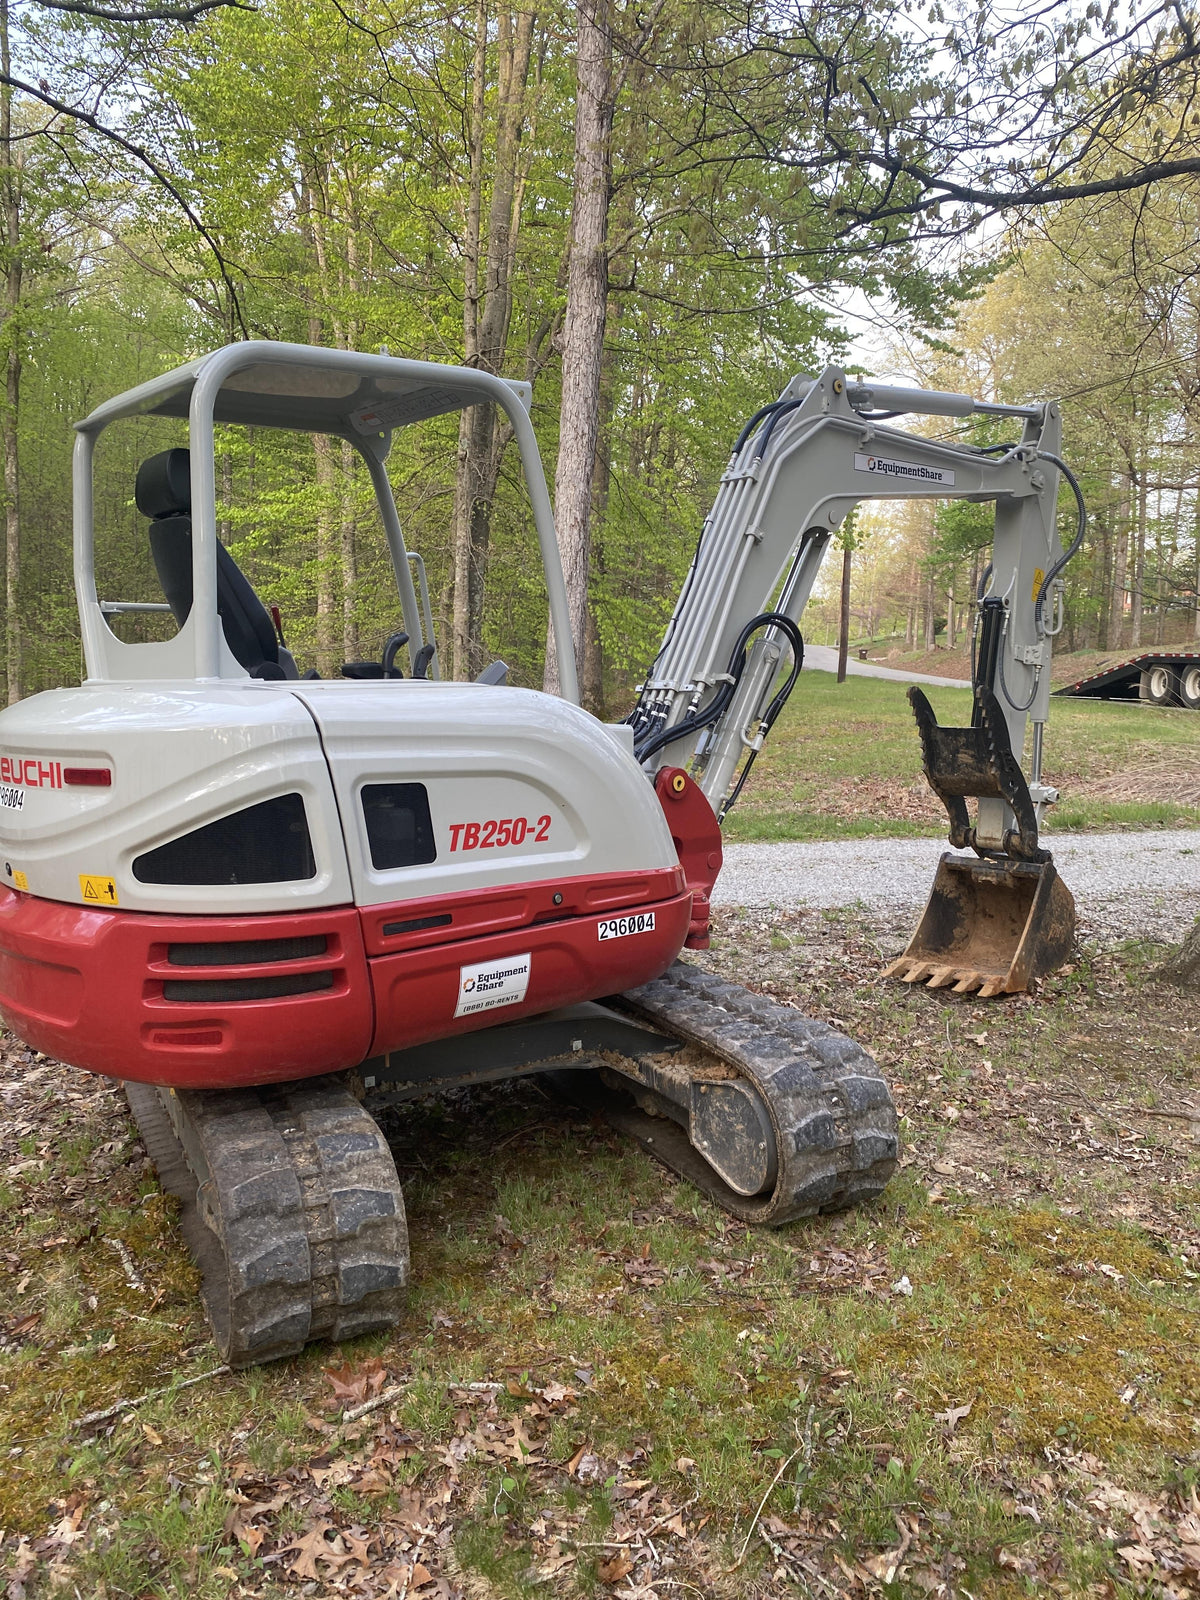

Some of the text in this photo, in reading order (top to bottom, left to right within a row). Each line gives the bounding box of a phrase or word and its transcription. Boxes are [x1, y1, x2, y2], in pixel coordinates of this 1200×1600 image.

[877, 460, 943, 481] EquipmentShare
[0, 757, 62, 789] EUCHI
[0, 786, 24, 810] 96004
[449, 815, 552, 852] TB250-2
[599, 913, 654, 940] 296004
[477, 965, 528, 983] Equipment
[476, 980, 504, 993] Share
